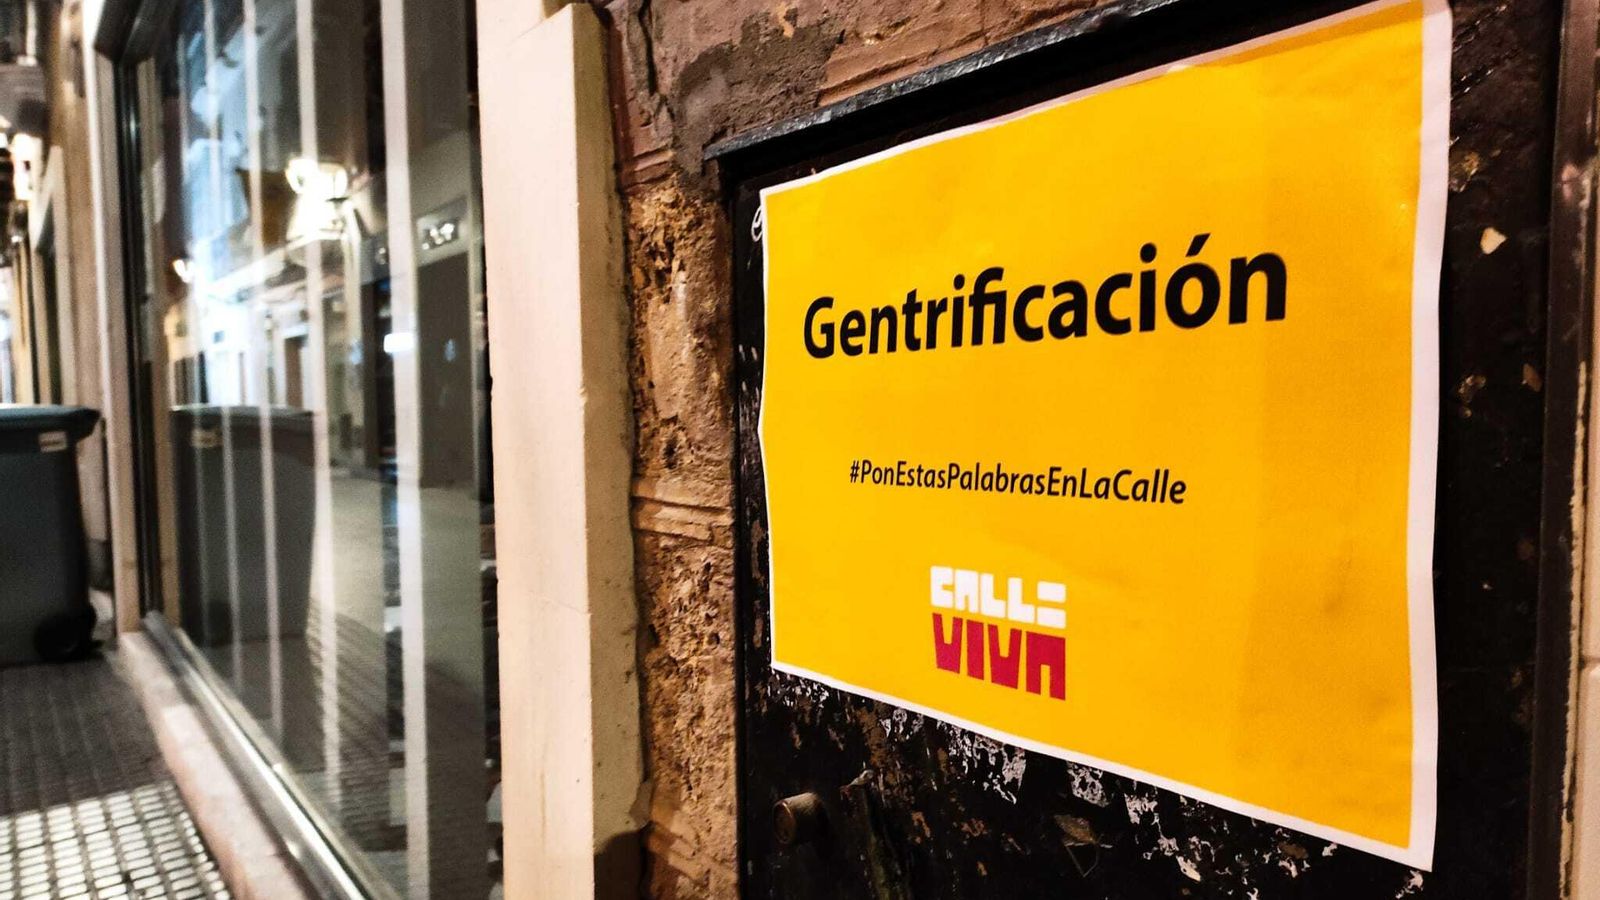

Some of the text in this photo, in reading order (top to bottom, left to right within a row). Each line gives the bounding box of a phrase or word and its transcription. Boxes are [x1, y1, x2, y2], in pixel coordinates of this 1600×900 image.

[804, 234, 1287, 359] Gentrificación
[850, 460, 1187, 504] #PonEstasPalabrasEnLaCalle
[931, 566, 1066, 628] CALLE
[933, 613, 1066, 700] VIVA
